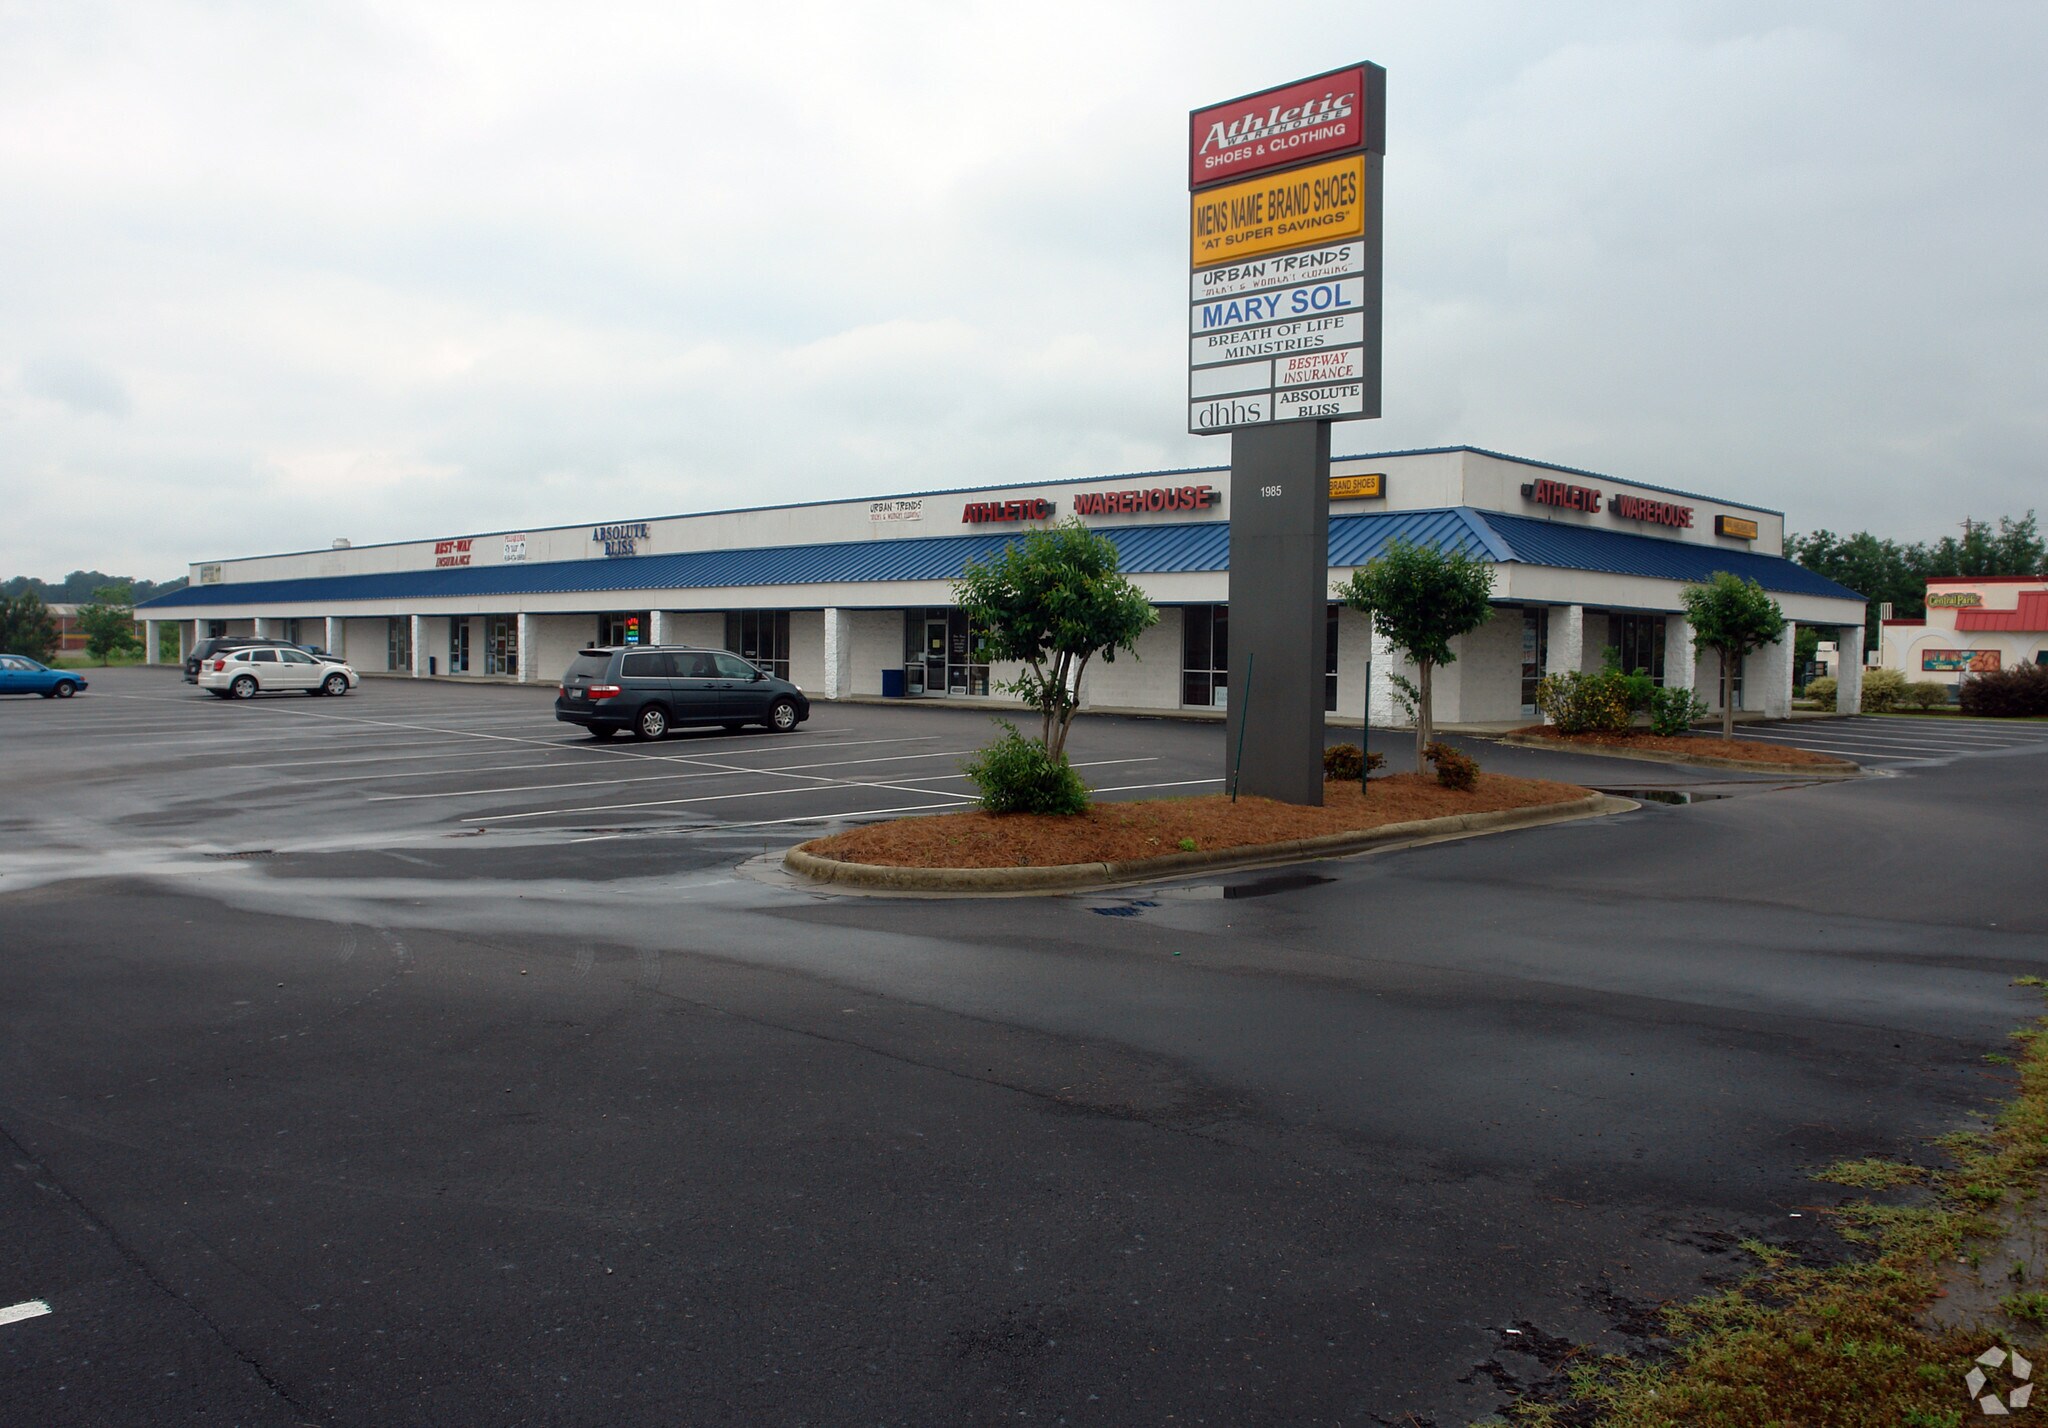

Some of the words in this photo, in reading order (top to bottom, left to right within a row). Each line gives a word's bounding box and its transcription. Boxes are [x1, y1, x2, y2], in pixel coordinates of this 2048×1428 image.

[1199, 92, 1355, 155] Athletic
[1227, 109, 1343, 146] WAREHOUSE
[1205, 147, 1252, 168] SHOES
[1256, 144, 1265, 156] &
[1270, 123, 1346, 151] CLOTHING
[1197, 201, 1228, 238] MENS
[1231, 193, 1263, 230] NAME
[1268, 182, 1310, 221] BRAND
[1313, 171, 1356, 212] SHOES
[1225, 227, 1273, 246] SUPER
[1278, 211, 1350, 234] SAVINGS"
[1203, 262, 1266, 285] URBAN
[1271, 246, 1351, 272] TRENDS
[1202, 293, 1282, 328] MARY
[1291, 283, 1352, 313] SOL
[1208, 327, 1271, 347] BREATH
[1277, 323, 1301, 337] OF
[1306, 316, 1344, 332] LIFE
[1224, 335, 1324, 359] MINISTRIES
[1288, 351, 1349, 370] BEST-WAY
[1283, 364, 1353, 384] INSURANCE
[1280, 385, 1360, 404] ABSOLUTE
[1199, 400, 1260, 428] dhhs
[1298, 403, 1340, 417] BLISS
[1260, 485, 1282, 498] 1985
[1329, 480, 1351, 491] BRAND
[1353, 478, 1376, 489] SHOES
[869, 502, 893, 513] URBAN
[896, 500, 922, 511] TRENDS
[961, 498, 1047, 523] ATHLETIC
[1074, 485, 1213, 515] WAREHOUSE
[1533, 478, 1601, 513] ATHLETIC
[1617, 494, 1694, 529] WAREHOUSE
[592, 523, 648, 541] ABSOLUTE
[435, 539, 473, 554] BEST-WAY
[604, 540, 634, 556] BLISS
